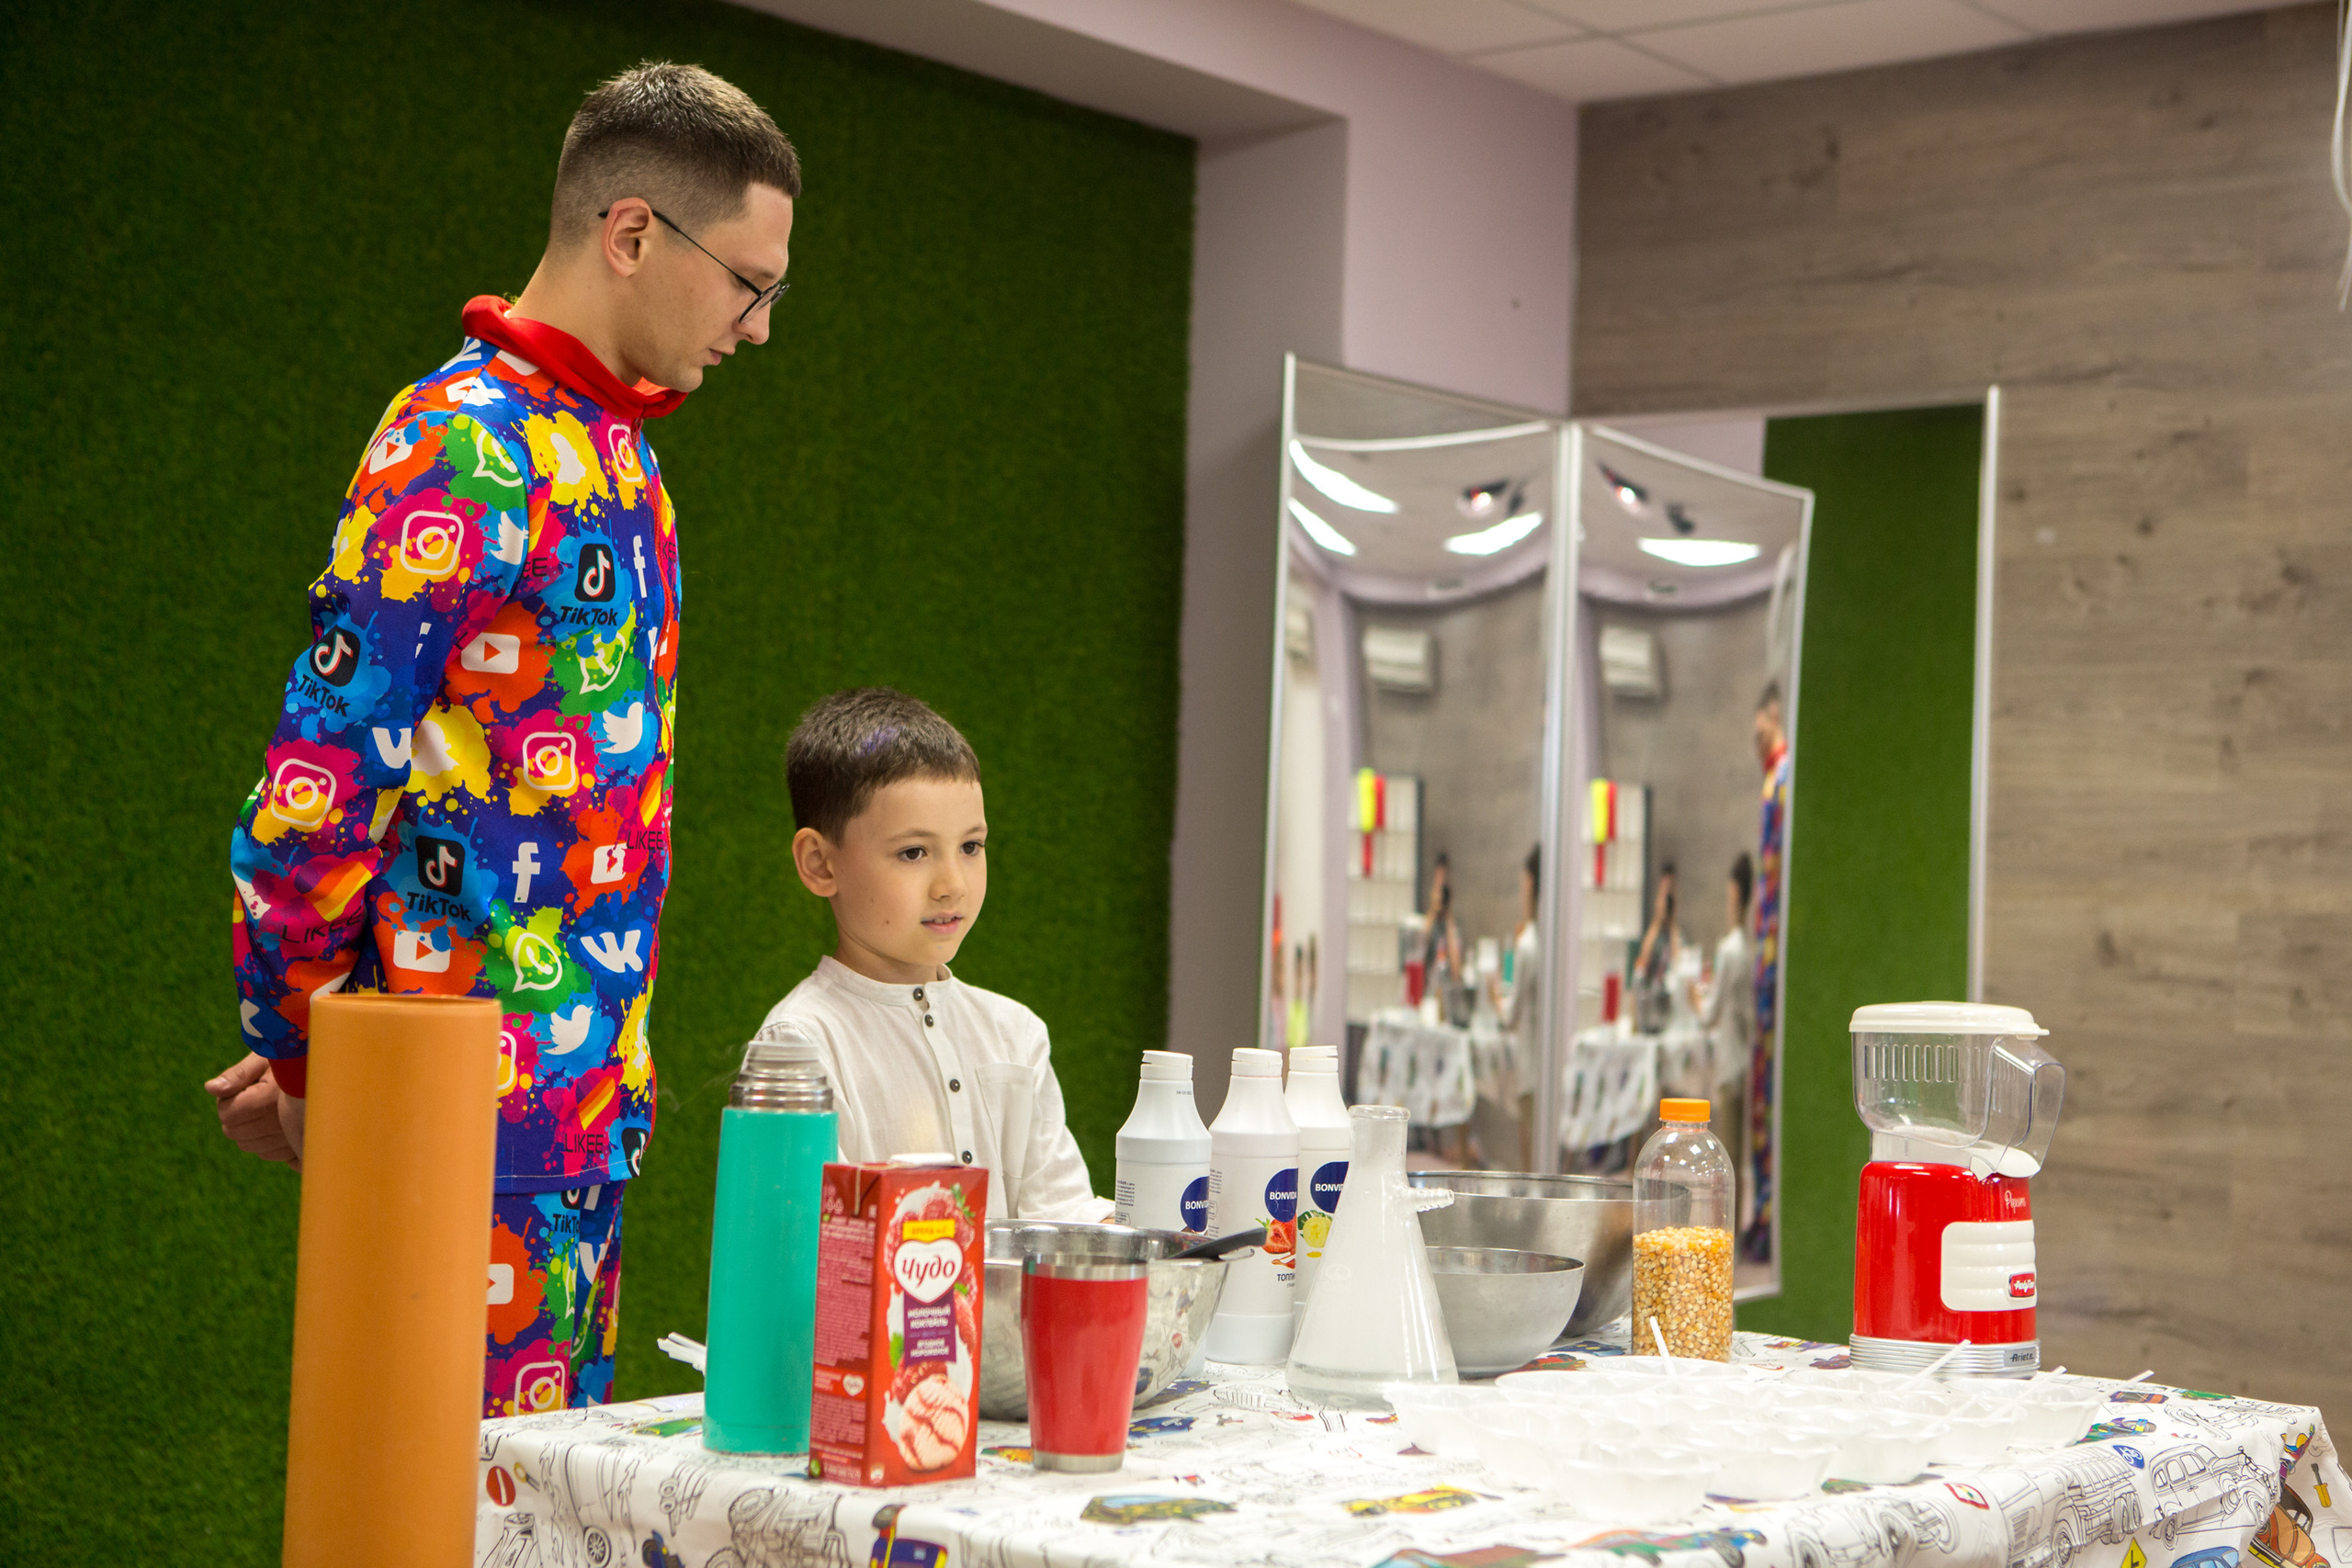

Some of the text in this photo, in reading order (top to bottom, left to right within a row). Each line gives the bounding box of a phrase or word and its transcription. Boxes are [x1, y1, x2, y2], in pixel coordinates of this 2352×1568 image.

[559, 605, 618, 626] TikTok
[295, 673, 351, 718] TikTok
[626, 829, 665, 851] LIKEE
[406, 891, 472, 922] TikTok
[281, 905, 363, 944] LIKEE
[564, 1134, 605, 1155] LIKEE
[902, 1256, 956, 1288] Чудо
